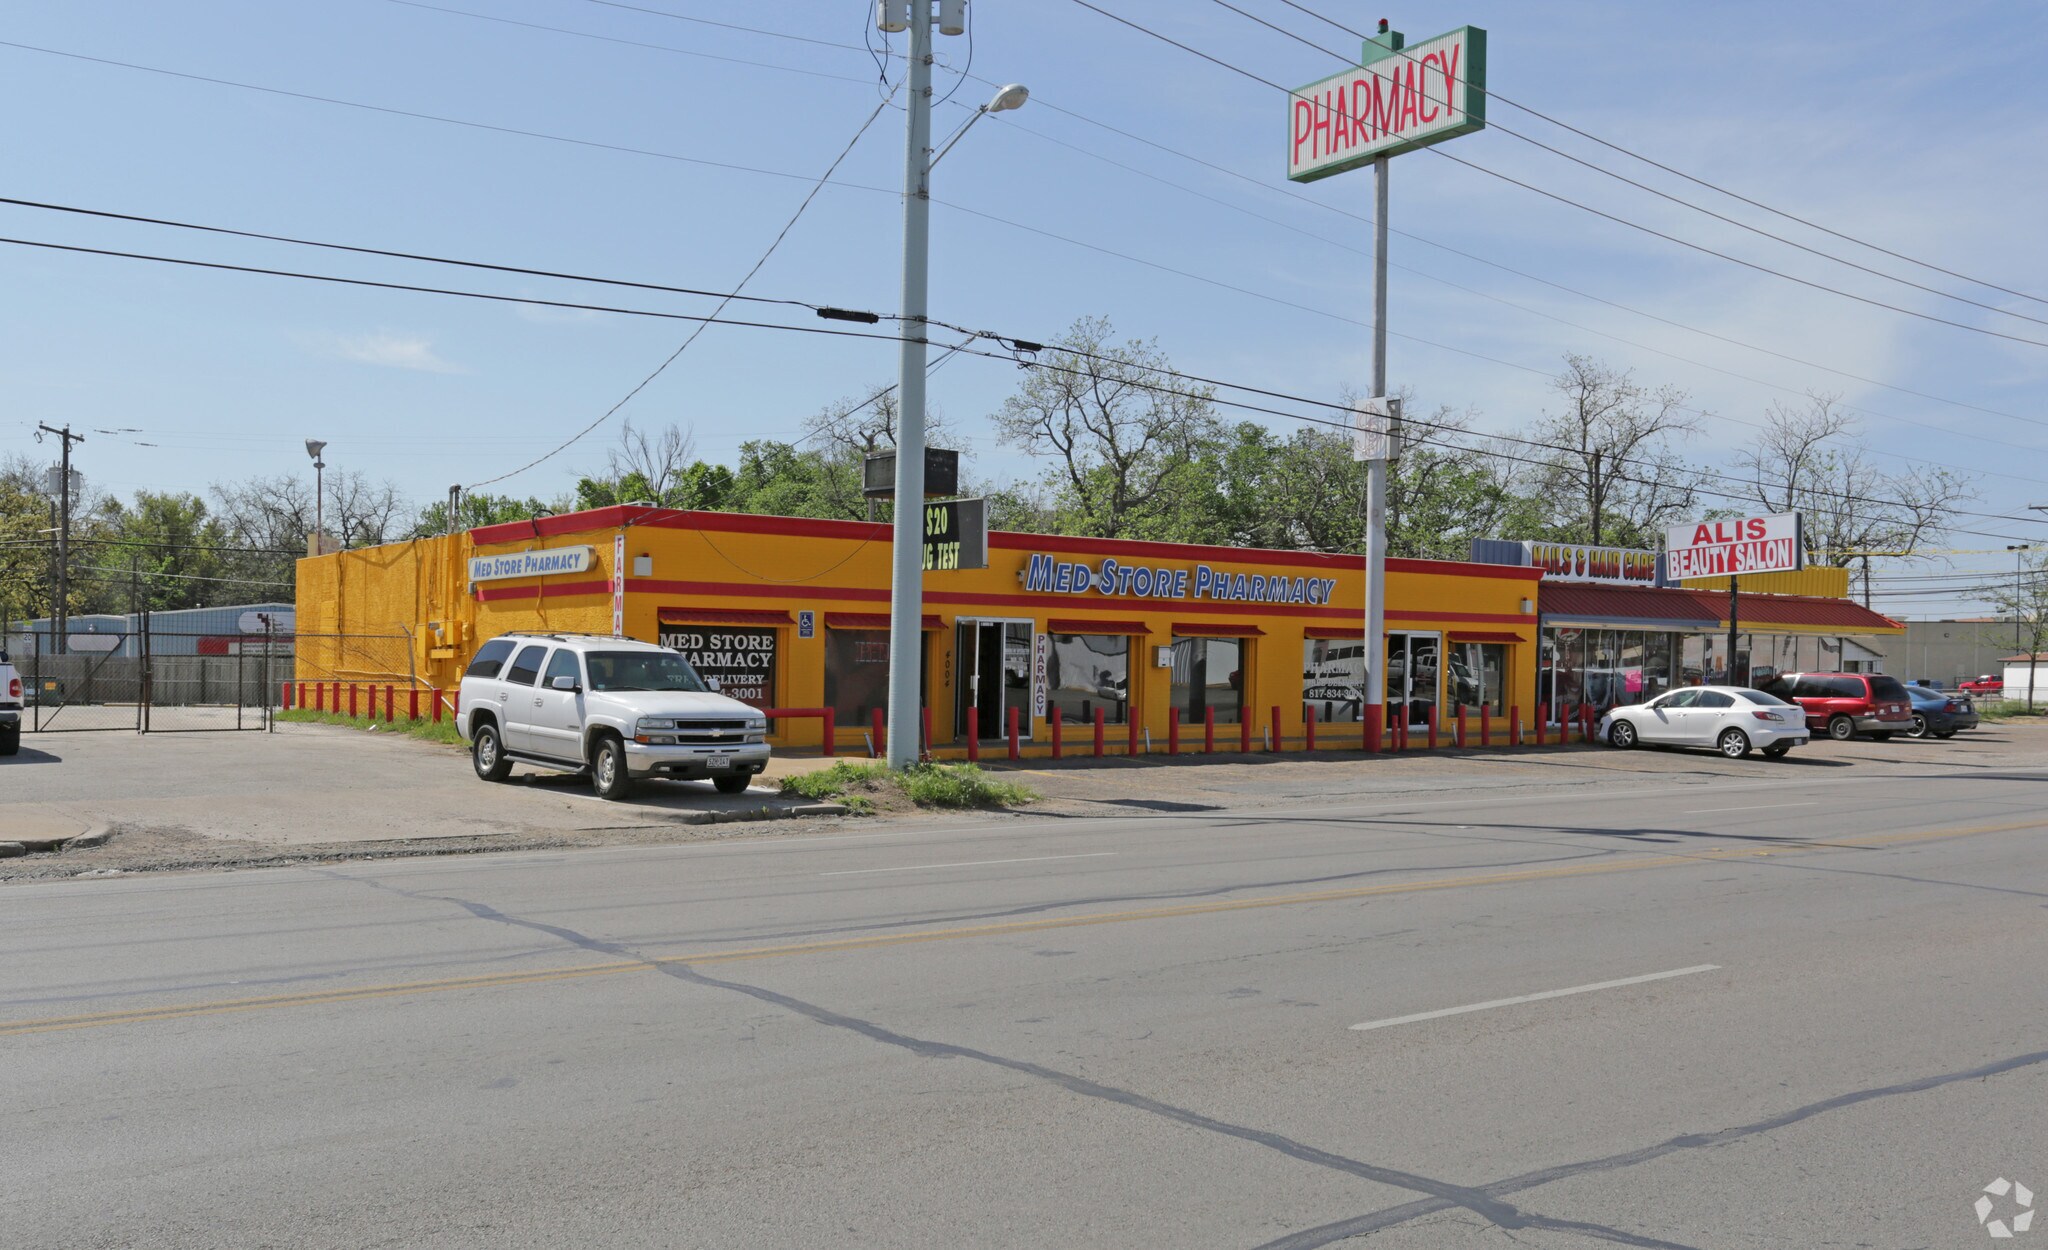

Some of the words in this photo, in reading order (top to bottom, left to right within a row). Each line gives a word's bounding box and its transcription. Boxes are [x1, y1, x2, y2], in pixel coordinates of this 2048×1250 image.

[1293, 43, 1460, 166] PHARMACY
[926, 505, 948, 536] $20
[1691, 518, 1767, 546] ALIS
[473, 561, 492, 578] MED
[494, 558, 522, 576] STORE
[524, 553, 581, 573] PHARMACY
[937, 541, 960, 570] TEST
[1531, 544, 1572, 576] NAILS
[1576, 550, 1586, 577] &
[1589, 550, 1620, 580] HAIR
[1623, 552, 1656, 582] CARE
[1669, 545, 1731, 578] BEAUTY
[1735, 539, 1790, 571] SALON
[614, 538, 622, 638] FARMA
[1026, 554, 1092, 594] MED
[1098, 558, 1188, 599] STORE
[1194, 564, 1337, 605] PHARMACY
[660, 633, 704, 649] MED
[710, 634, 774, 650] STORE
[1036, 635, 1045, 714] PHARMACY
[1303, 662, 1362, 674] PHARMAC
